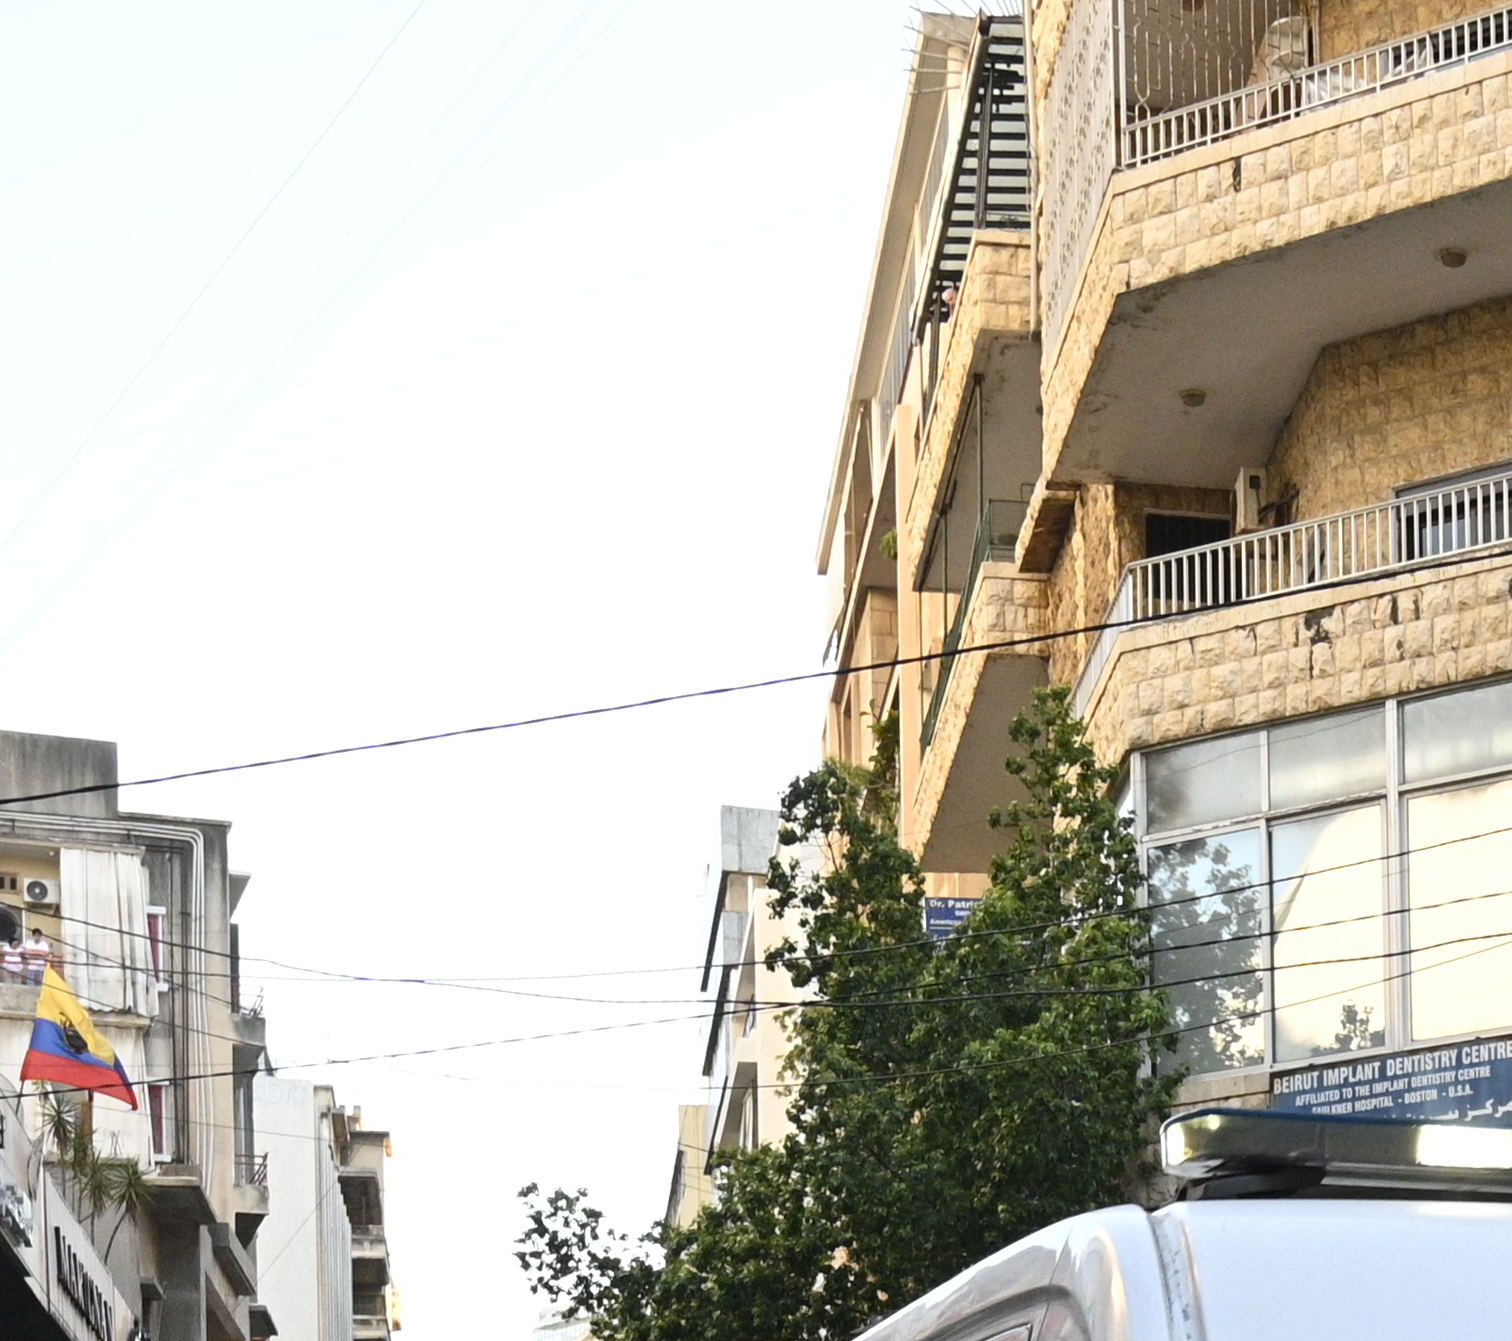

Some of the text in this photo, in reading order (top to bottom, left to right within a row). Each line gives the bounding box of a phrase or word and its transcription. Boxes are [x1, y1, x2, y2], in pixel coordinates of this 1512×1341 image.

[1274, 1071, 1319, 1095] BEIRUT
[1323, 1061, 1380, 1087] IMPLANT
[1386, 1049, 1457, 1080] DENTISTRY
[1295, 1064, 1491, 1107] AFFILIATED TO THE IMPLANT DENTISTRY CENTRE
[1354, 1095, 1394, 1112] HOSPITAL
[1404, 1089, 1437, 1104] BOSTON
